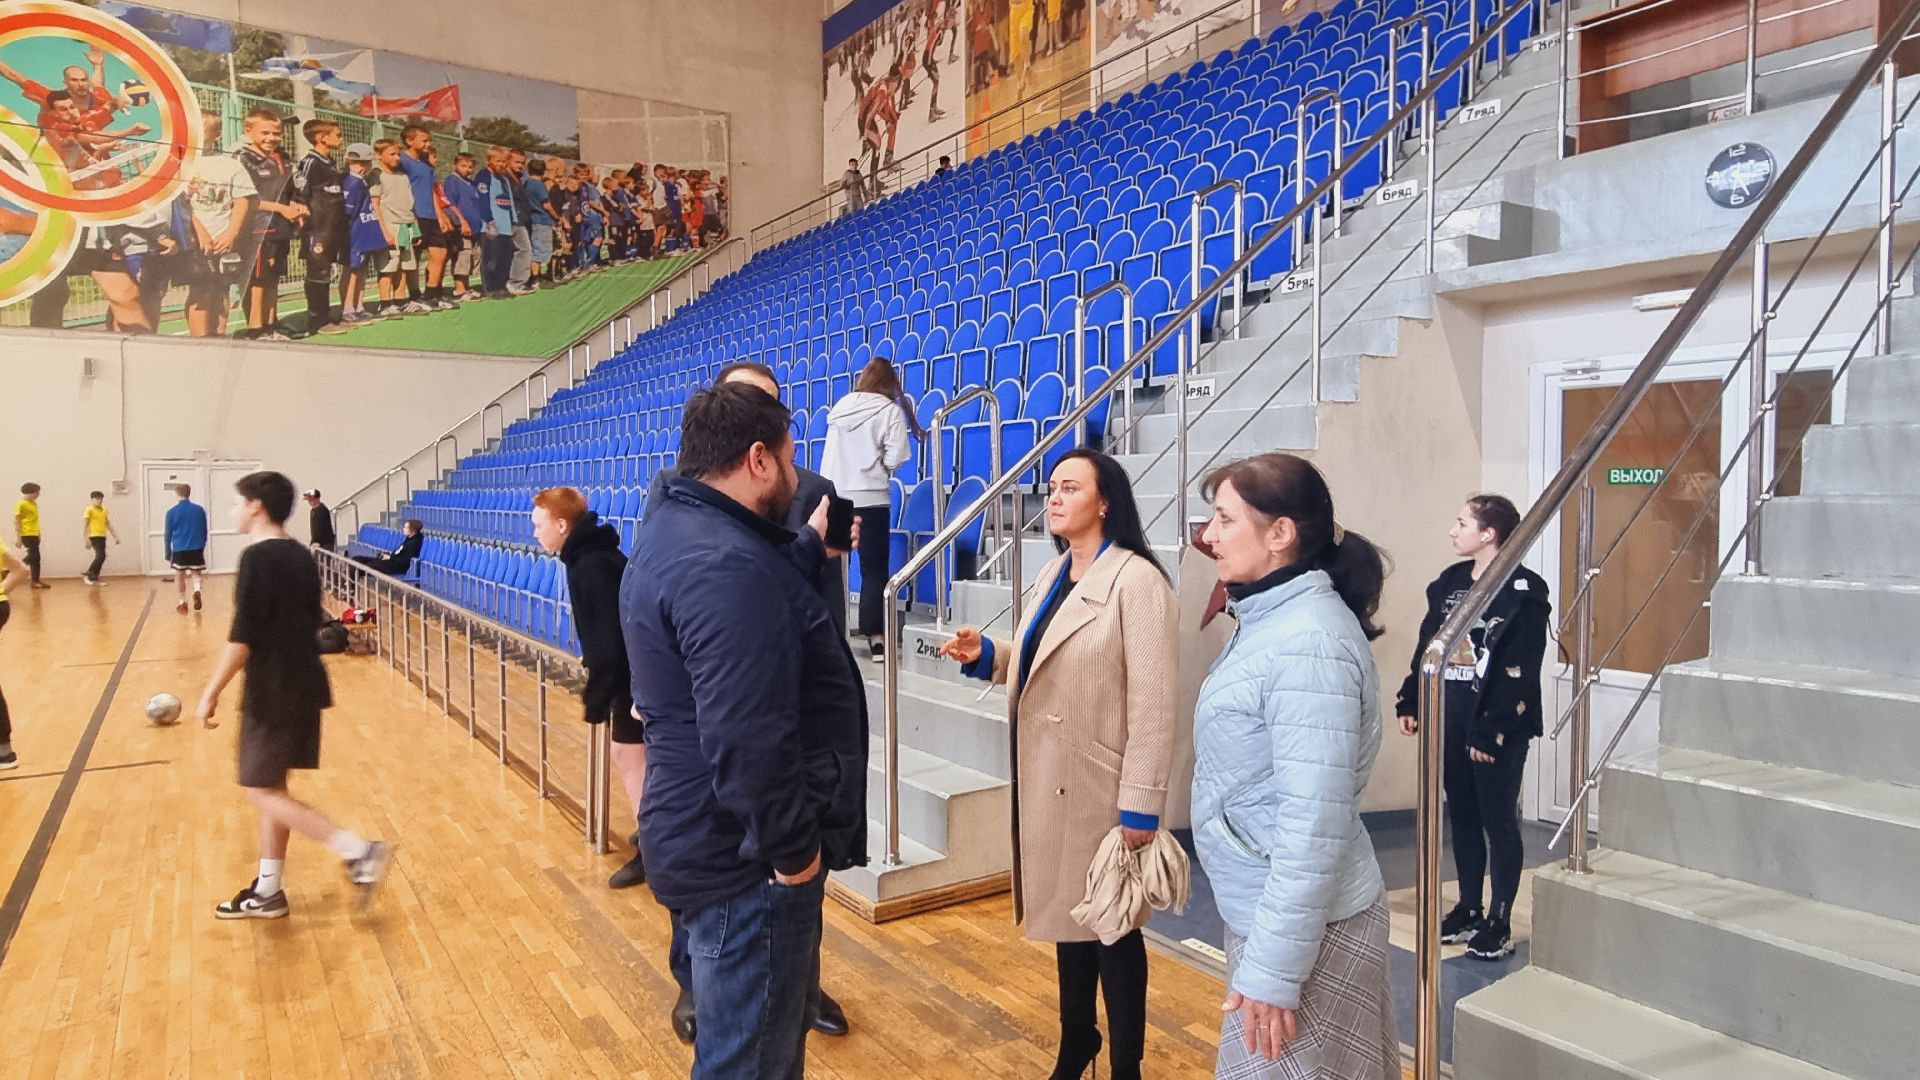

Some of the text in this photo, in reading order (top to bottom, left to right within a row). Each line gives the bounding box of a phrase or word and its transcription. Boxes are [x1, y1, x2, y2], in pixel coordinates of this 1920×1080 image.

[1729, 144, 1746, 158] 12
[1382, 187, 1412, 201] 6РЯД
[1730, 194, 1744, 205] 6
